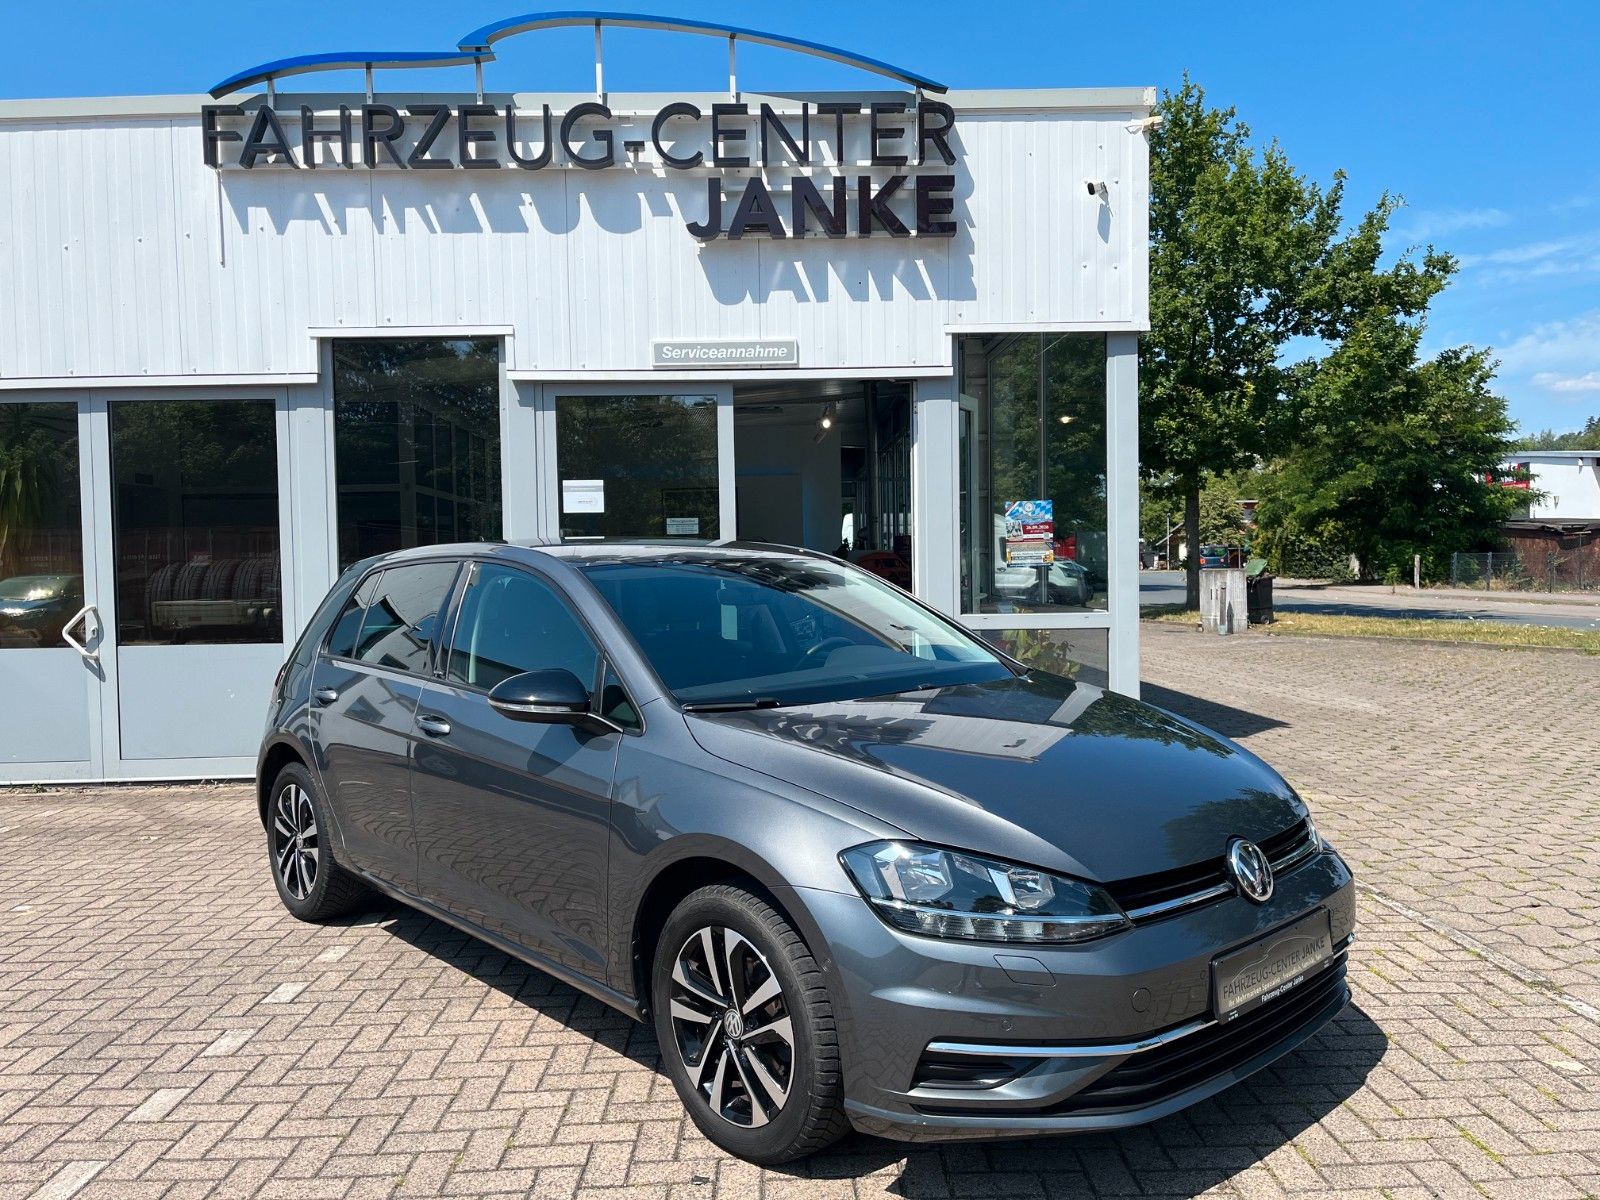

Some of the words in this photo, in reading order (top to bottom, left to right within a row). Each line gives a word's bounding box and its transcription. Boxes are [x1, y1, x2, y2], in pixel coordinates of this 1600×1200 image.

[201, 101, 956, 170] FAHRZEUG-CENTER
[686, 174, 958, 241] JANKE
[661, 344, 788, 360] Serviceannahme
[1223, 950, 1301, 999] FAHRZEUG-CENTER
[1302, 936, 1325, 959] JANKE
